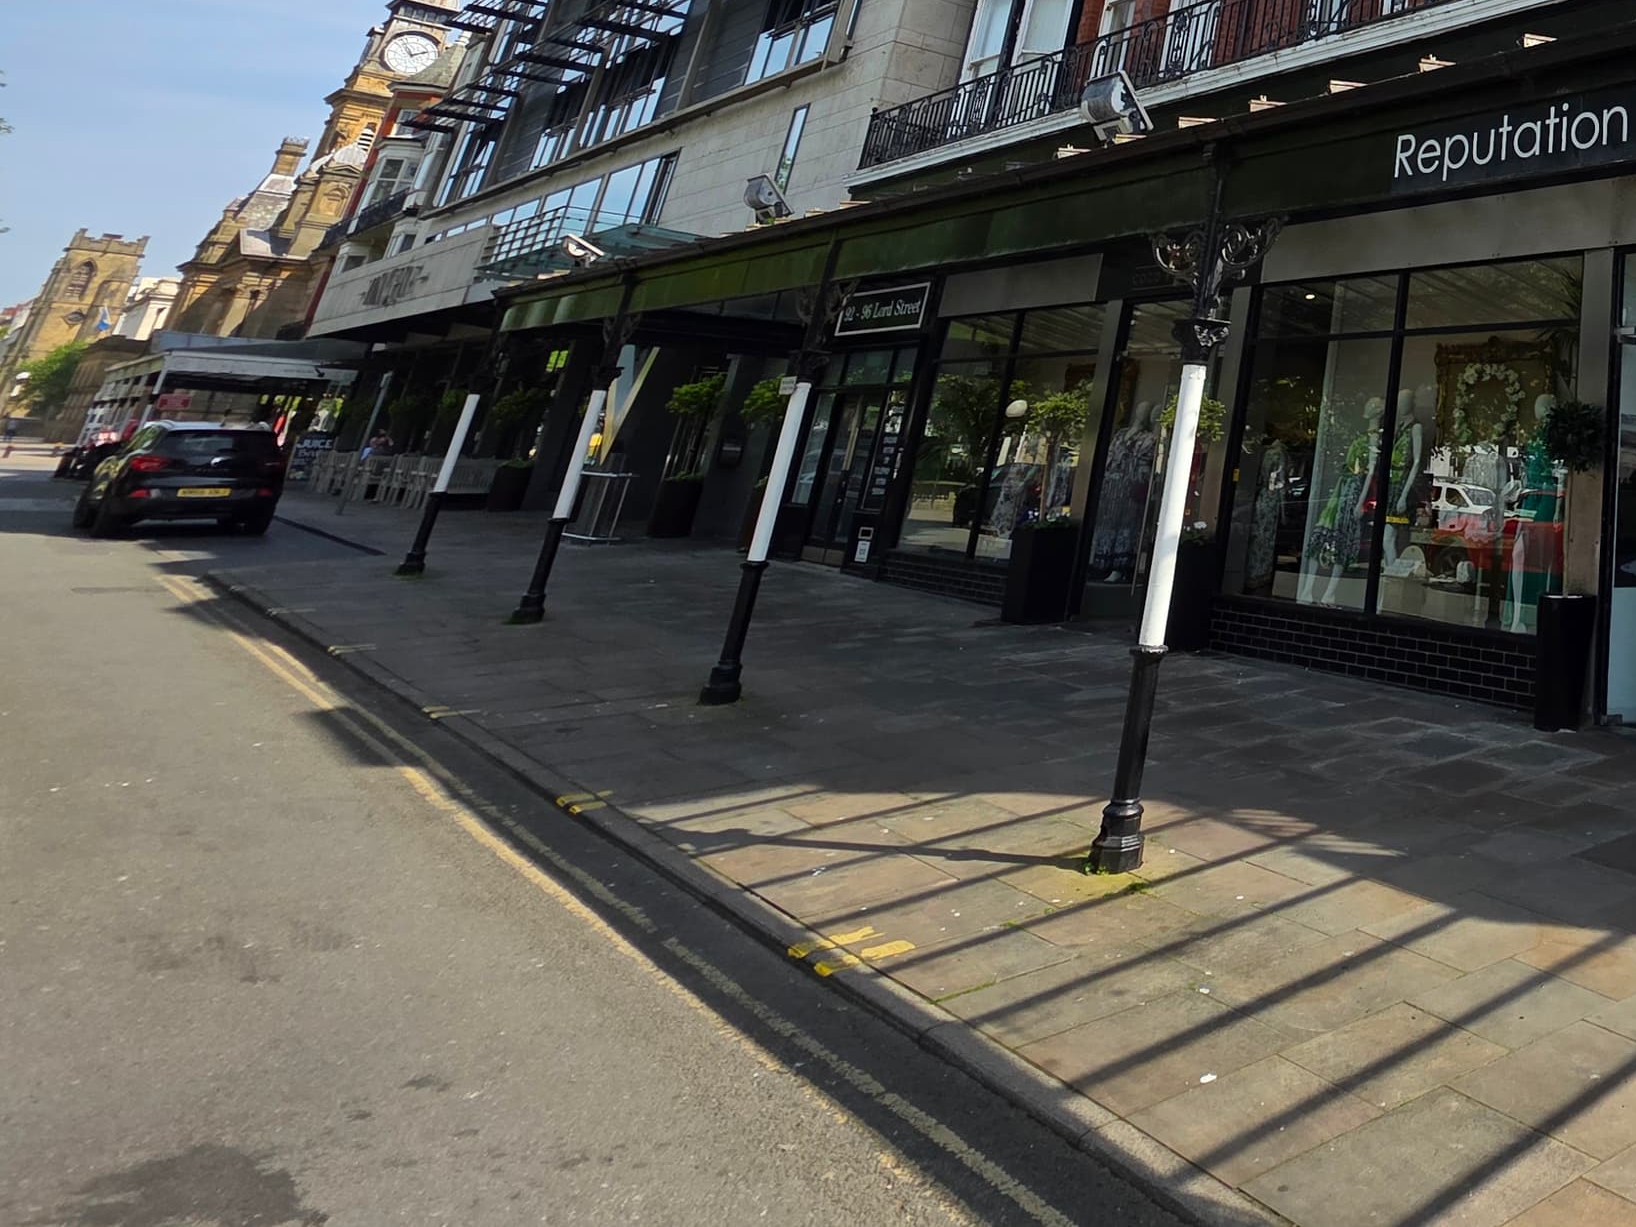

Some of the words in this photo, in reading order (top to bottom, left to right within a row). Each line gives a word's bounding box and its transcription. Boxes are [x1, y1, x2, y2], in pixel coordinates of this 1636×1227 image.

[1393, 102, 1629, 182] Reputation
[873, 300, 893, 318] Lord
[894, 299, 921, 316] Street
